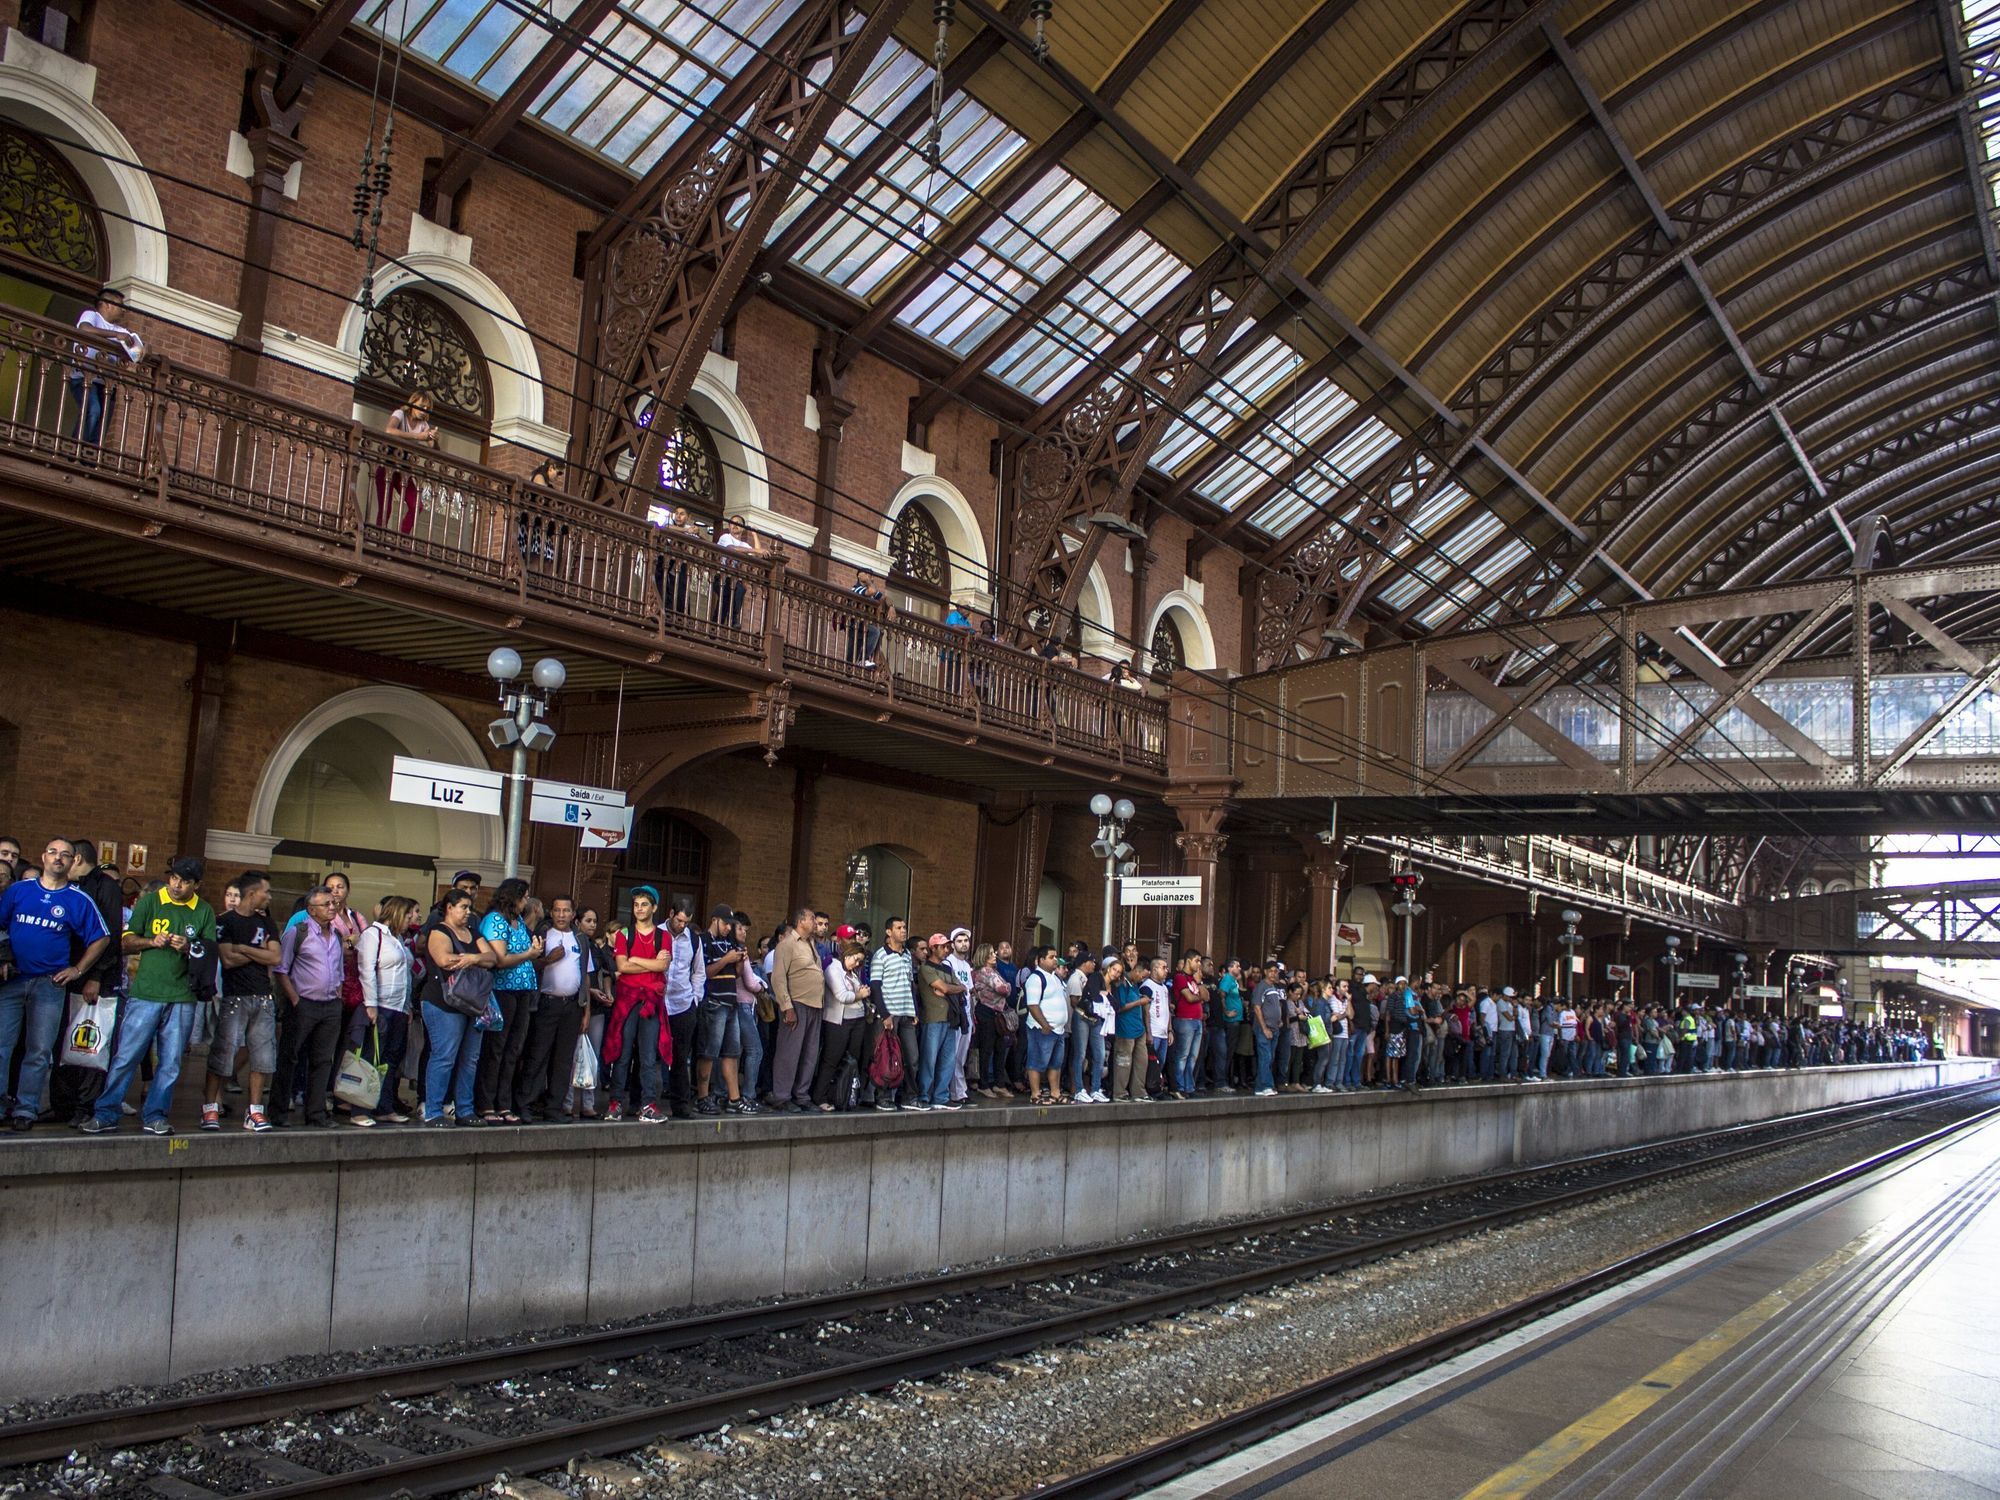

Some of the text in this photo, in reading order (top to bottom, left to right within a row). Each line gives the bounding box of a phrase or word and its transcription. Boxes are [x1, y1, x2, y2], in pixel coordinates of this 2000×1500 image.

[431, 782, 464, 804] Luz
[570, 788, 590, 800] Saída
[1143, 893, 1194, 902] Guaianazes
[152, 918, 170, 935] 62
